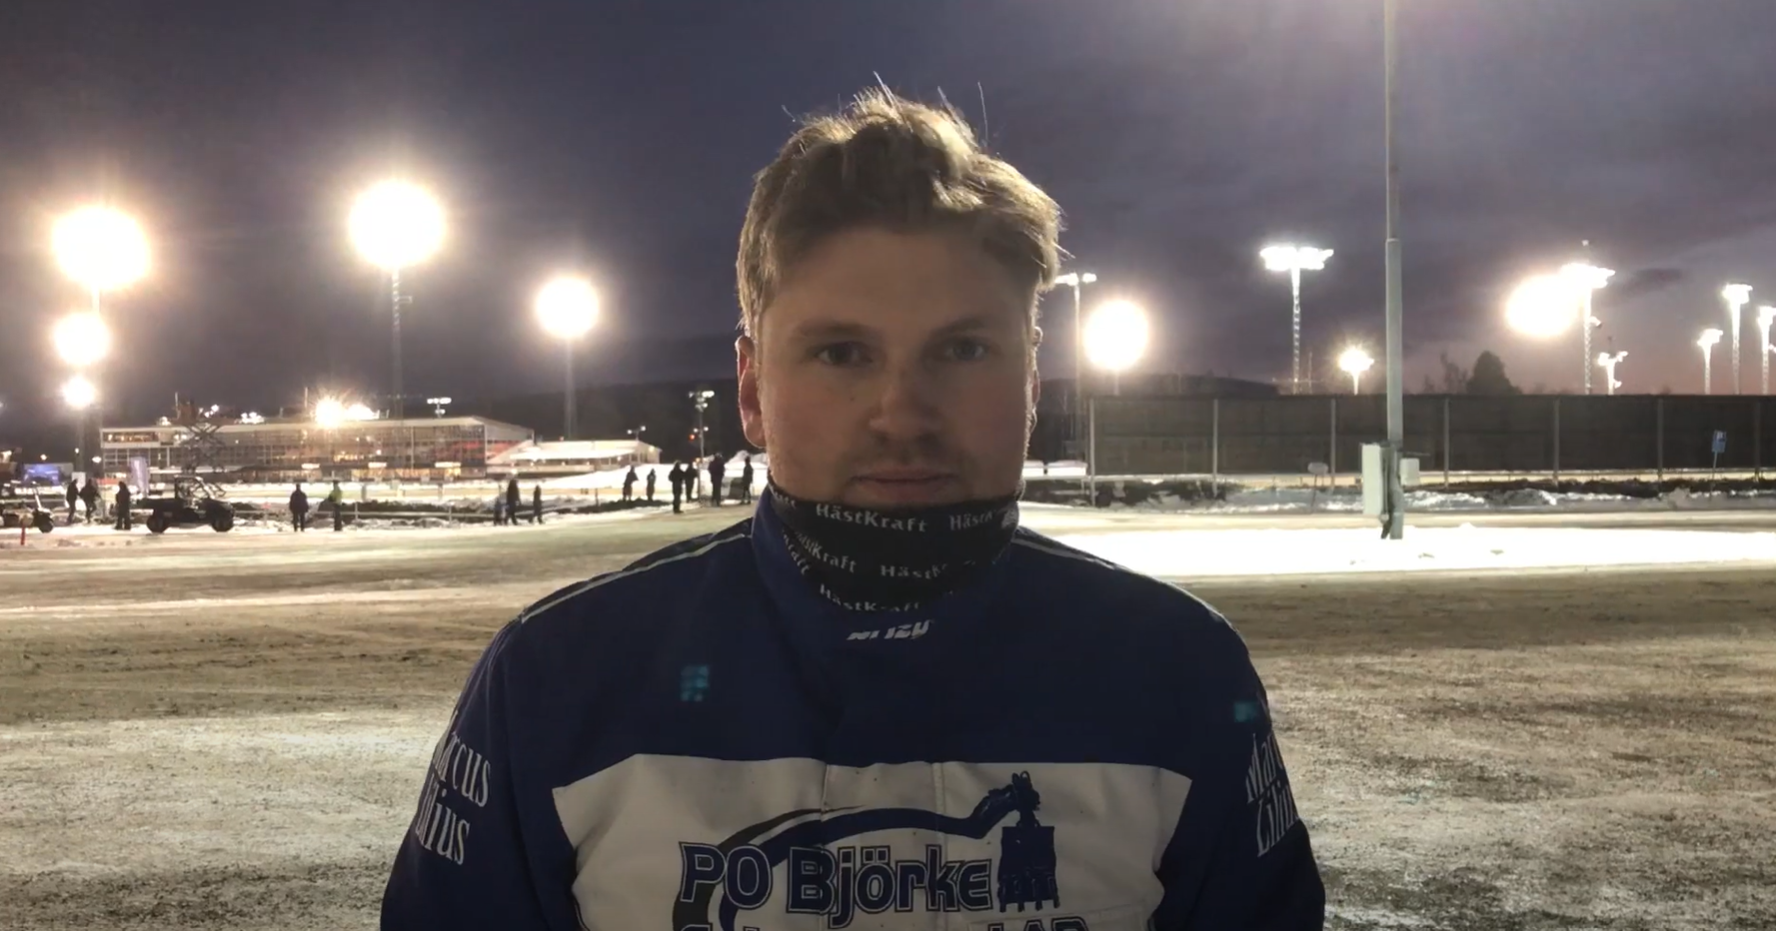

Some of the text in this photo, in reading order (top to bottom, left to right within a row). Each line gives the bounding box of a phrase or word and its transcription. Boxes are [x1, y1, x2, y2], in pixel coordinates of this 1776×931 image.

[816, 503, 928, 532] HästKraft
[678, 841, 992, 929] PO Björke
